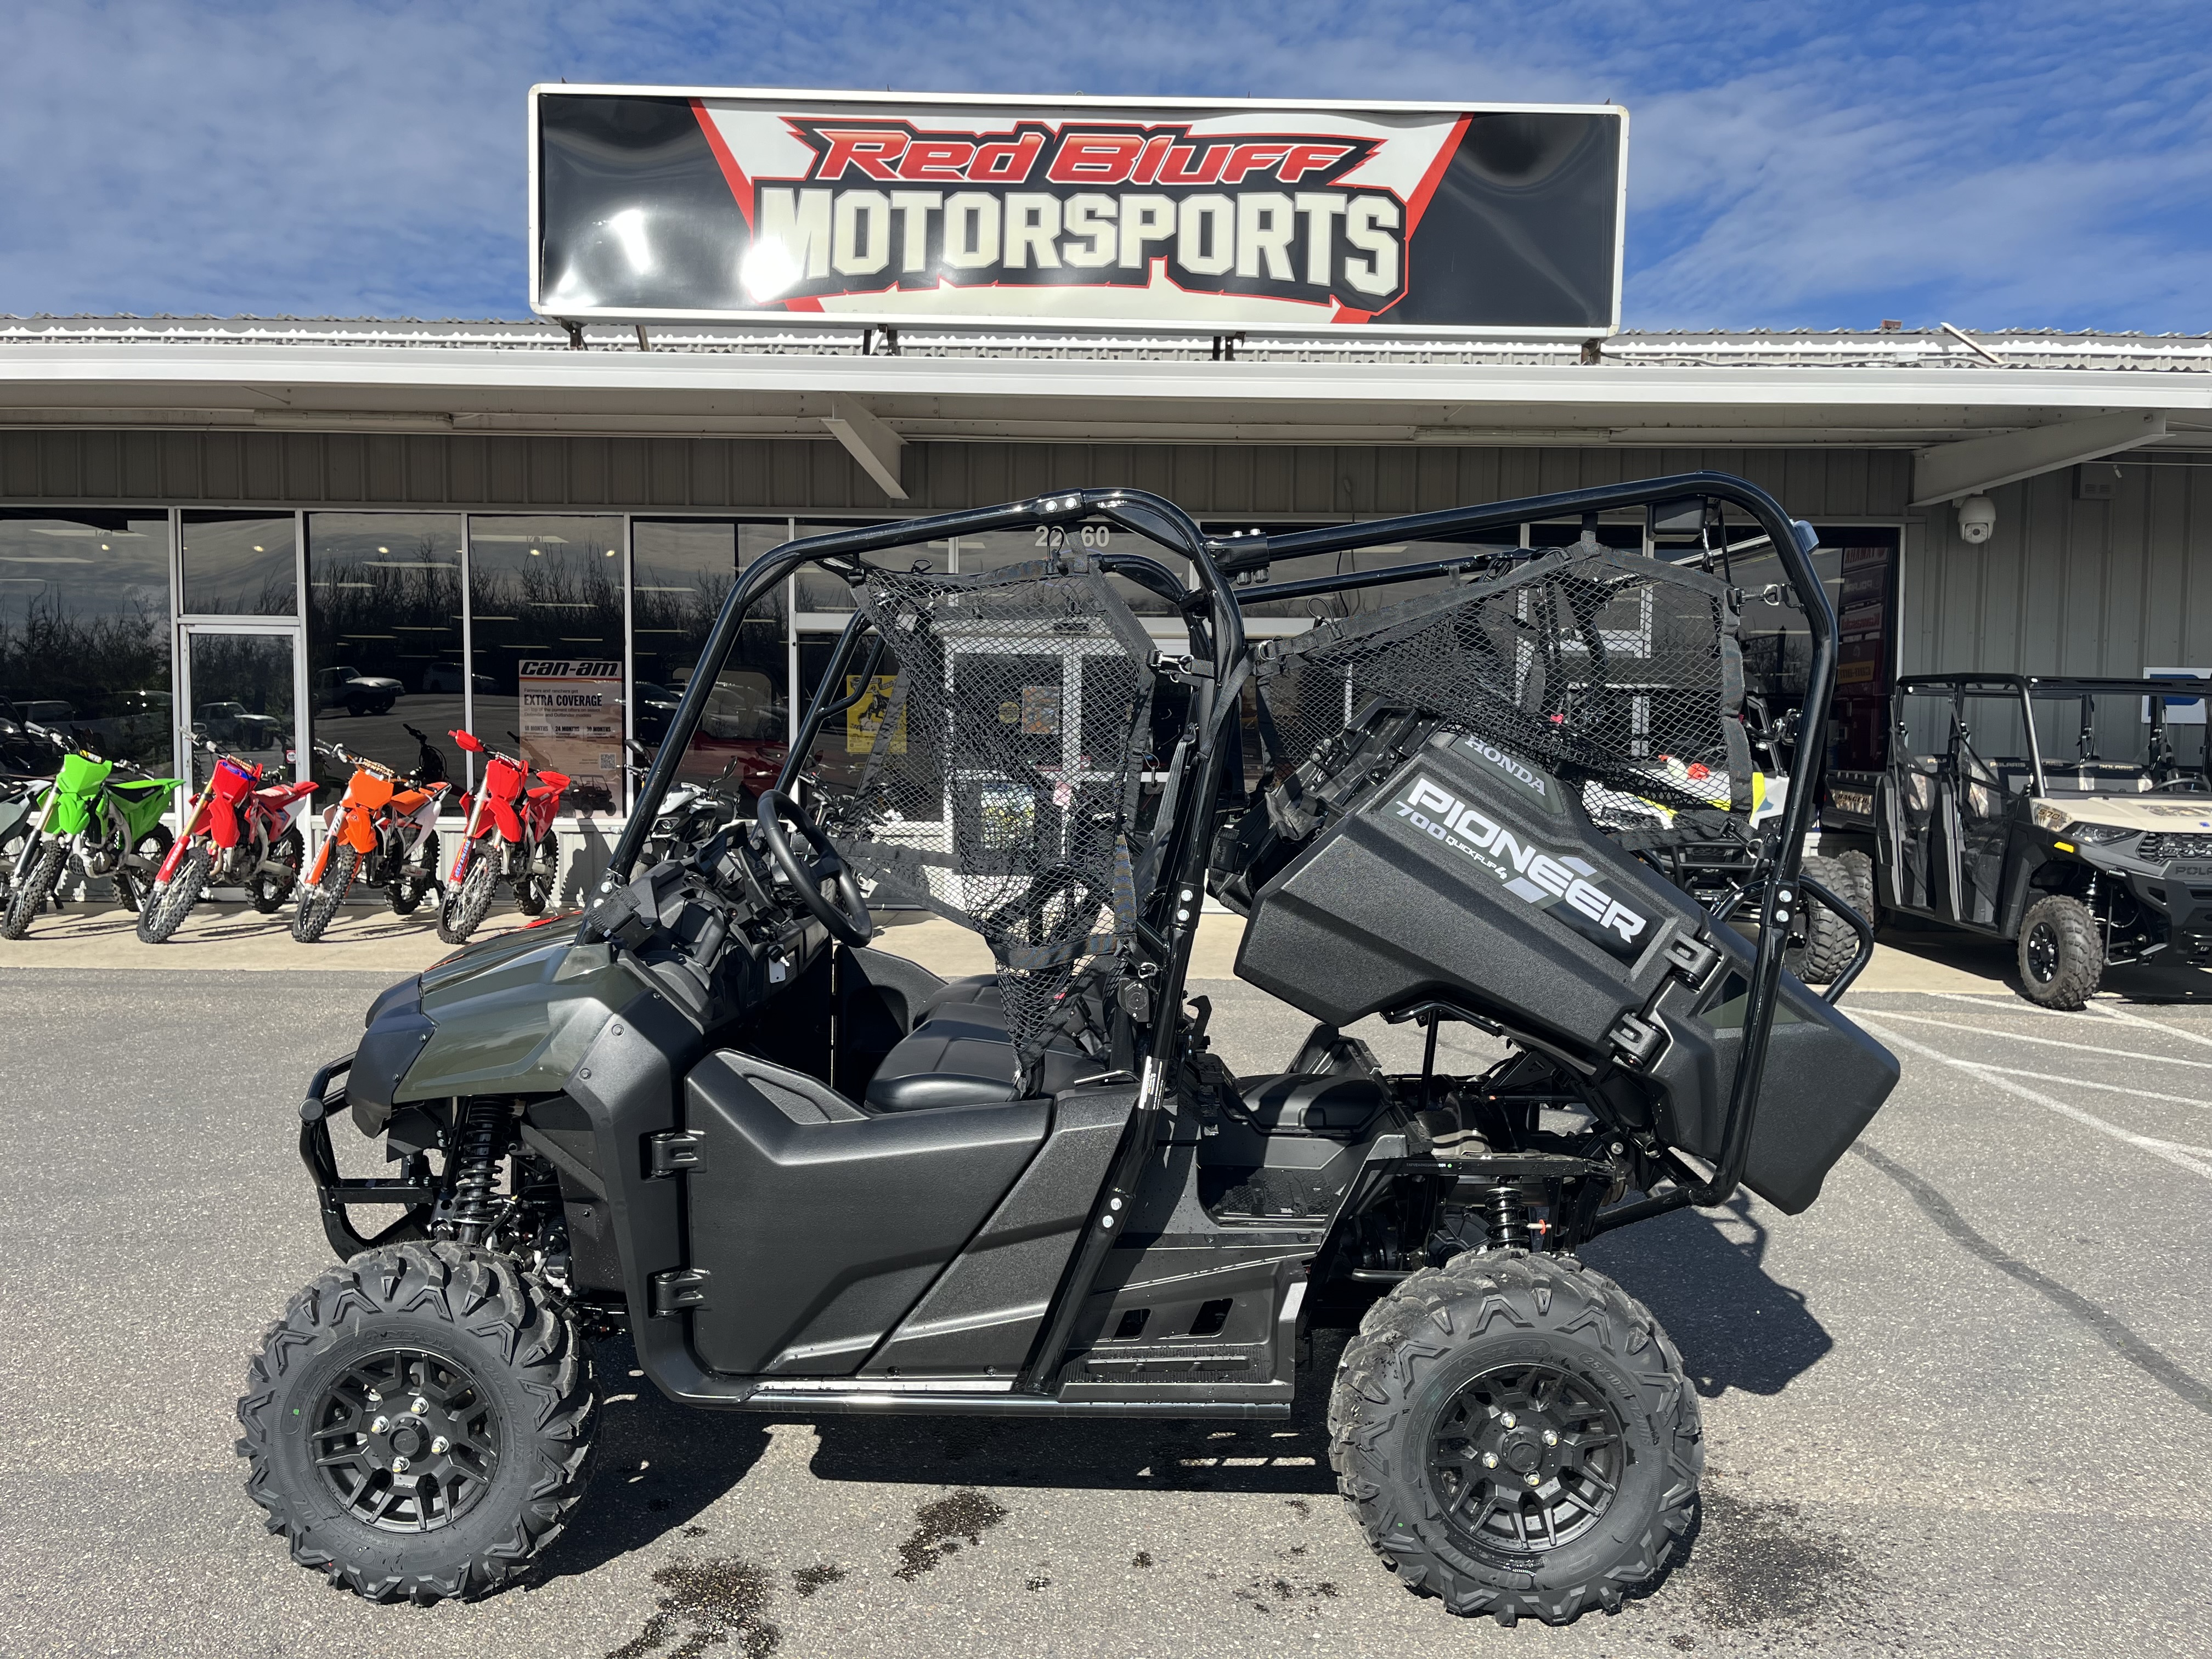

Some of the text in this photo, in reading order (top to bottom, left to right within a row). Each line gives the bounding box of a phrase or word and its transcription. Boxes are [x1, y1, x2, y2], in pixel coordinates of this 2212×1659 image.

[812, 128, 1046, 183] Red
[760, 187, 1400, 296] MOTORSPORTS
[1035, 525, 1109, 547] 2260
[521, 661, 618, 676] can-am
[524, 695, 602, 707] EXTRA COVERAGE
[1464, 735, 1547, 796] HONDA
[1838, 794, 1868, 805] RANGER
[2038, 809, 2061, 820] 570
[1396, 800, 1508, 880] 700 QUICKFLIP 4
[1407, 778, 1646, 943] PIONEER
